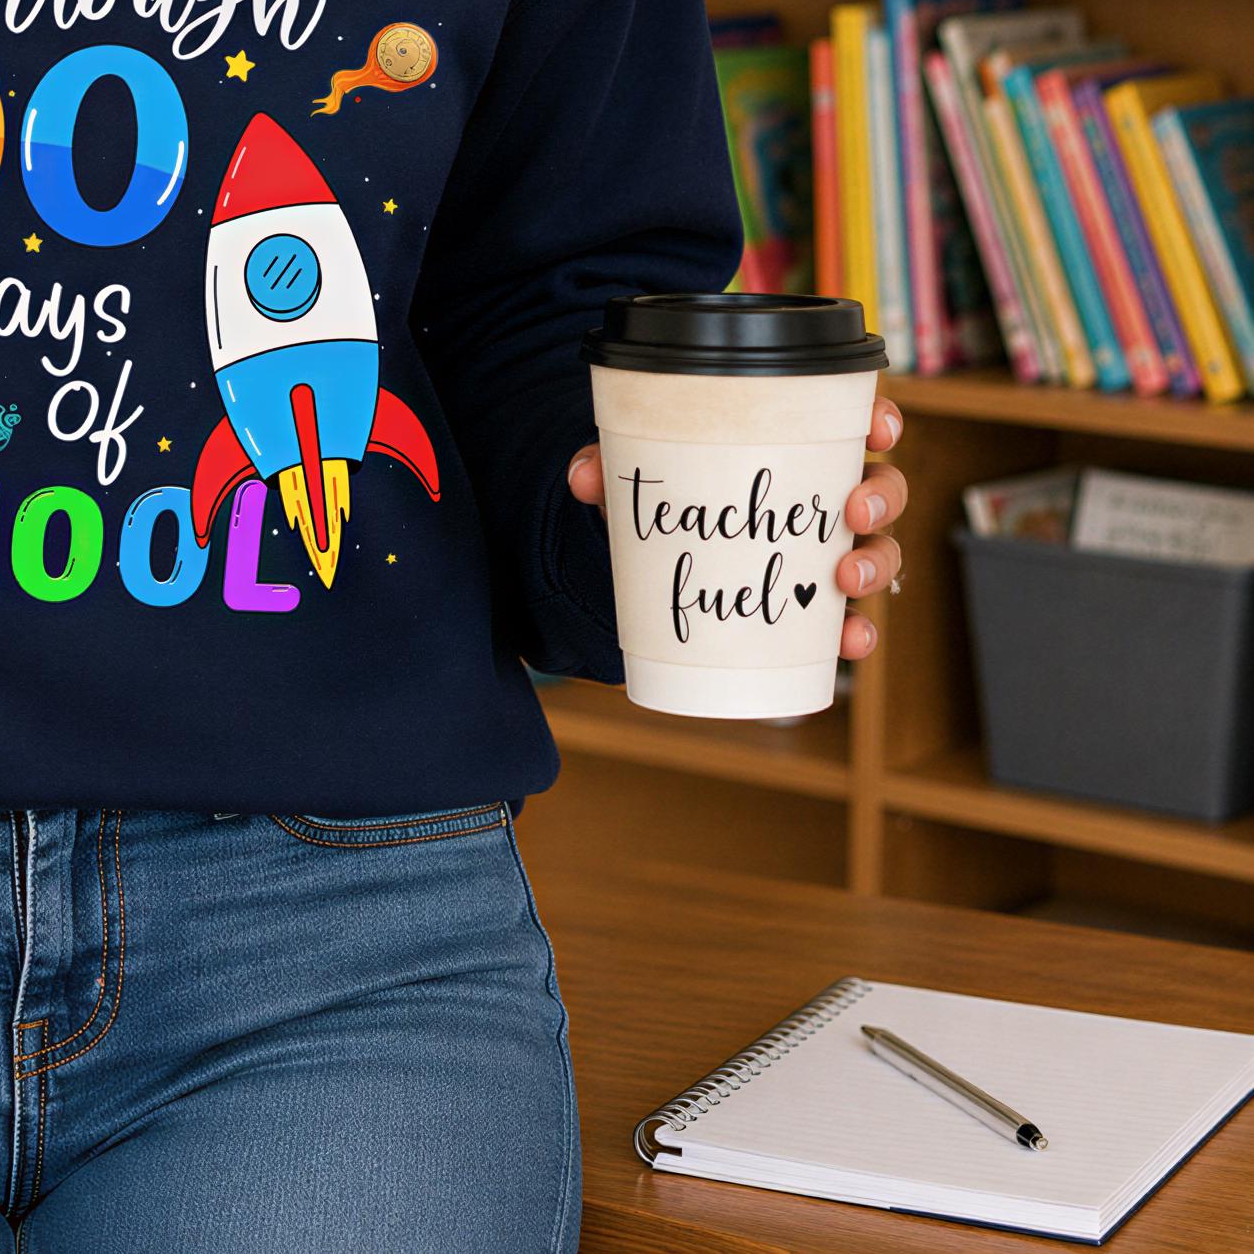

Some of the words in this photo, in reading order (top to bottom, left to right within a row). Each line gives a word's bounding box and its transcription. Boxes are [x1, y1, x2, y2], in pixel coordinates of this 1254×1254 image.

[46, 359, 145, 487] of
[618, 467, 840, 544] teacher
[670, 551, 788, 644] fuel
